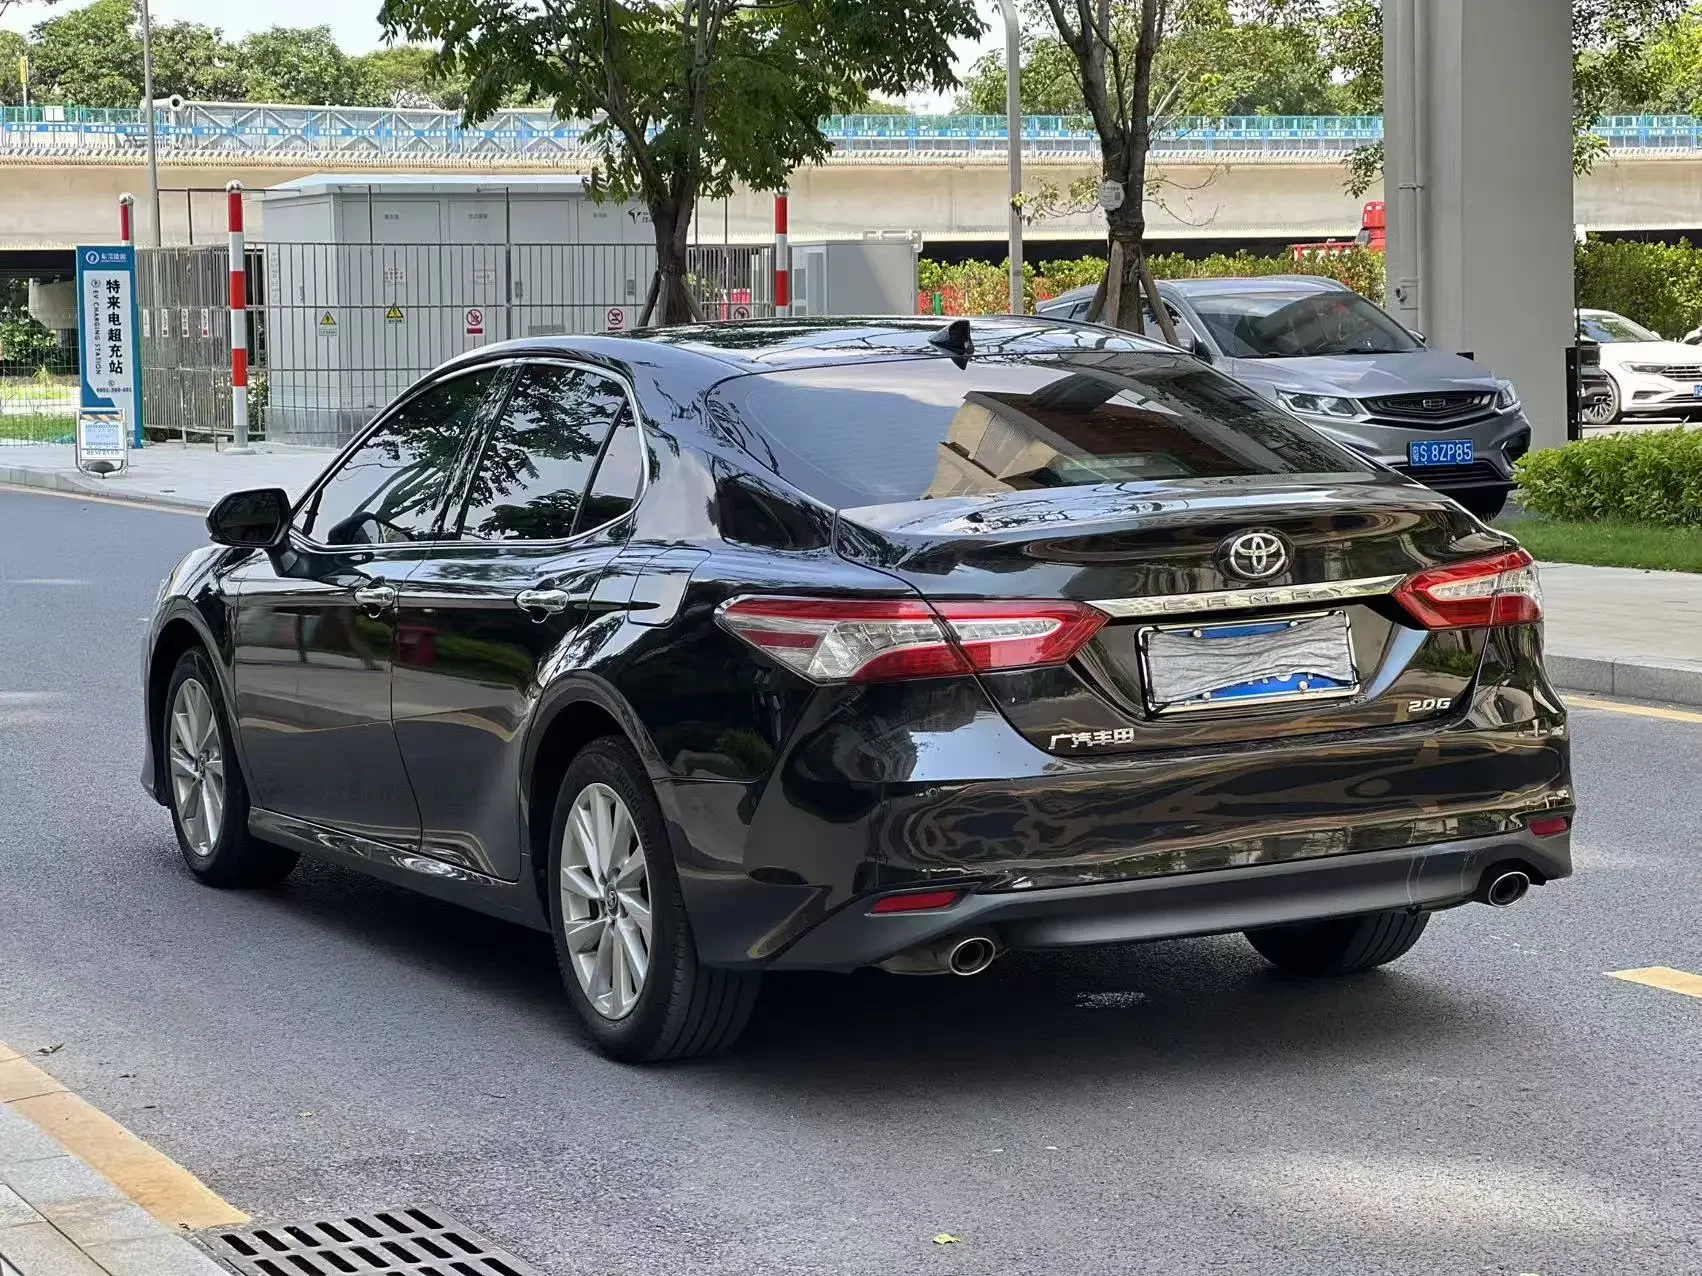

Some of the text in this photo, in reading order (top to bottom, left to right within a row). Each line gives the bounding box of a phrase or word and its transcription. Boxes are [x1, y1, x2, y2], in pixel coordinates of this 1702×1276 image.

[92, 290, 99, 299] EV
[106, 279, 123, 375] 特来电超充站
[1048, 728, 1134, 750] 广汽丰田
